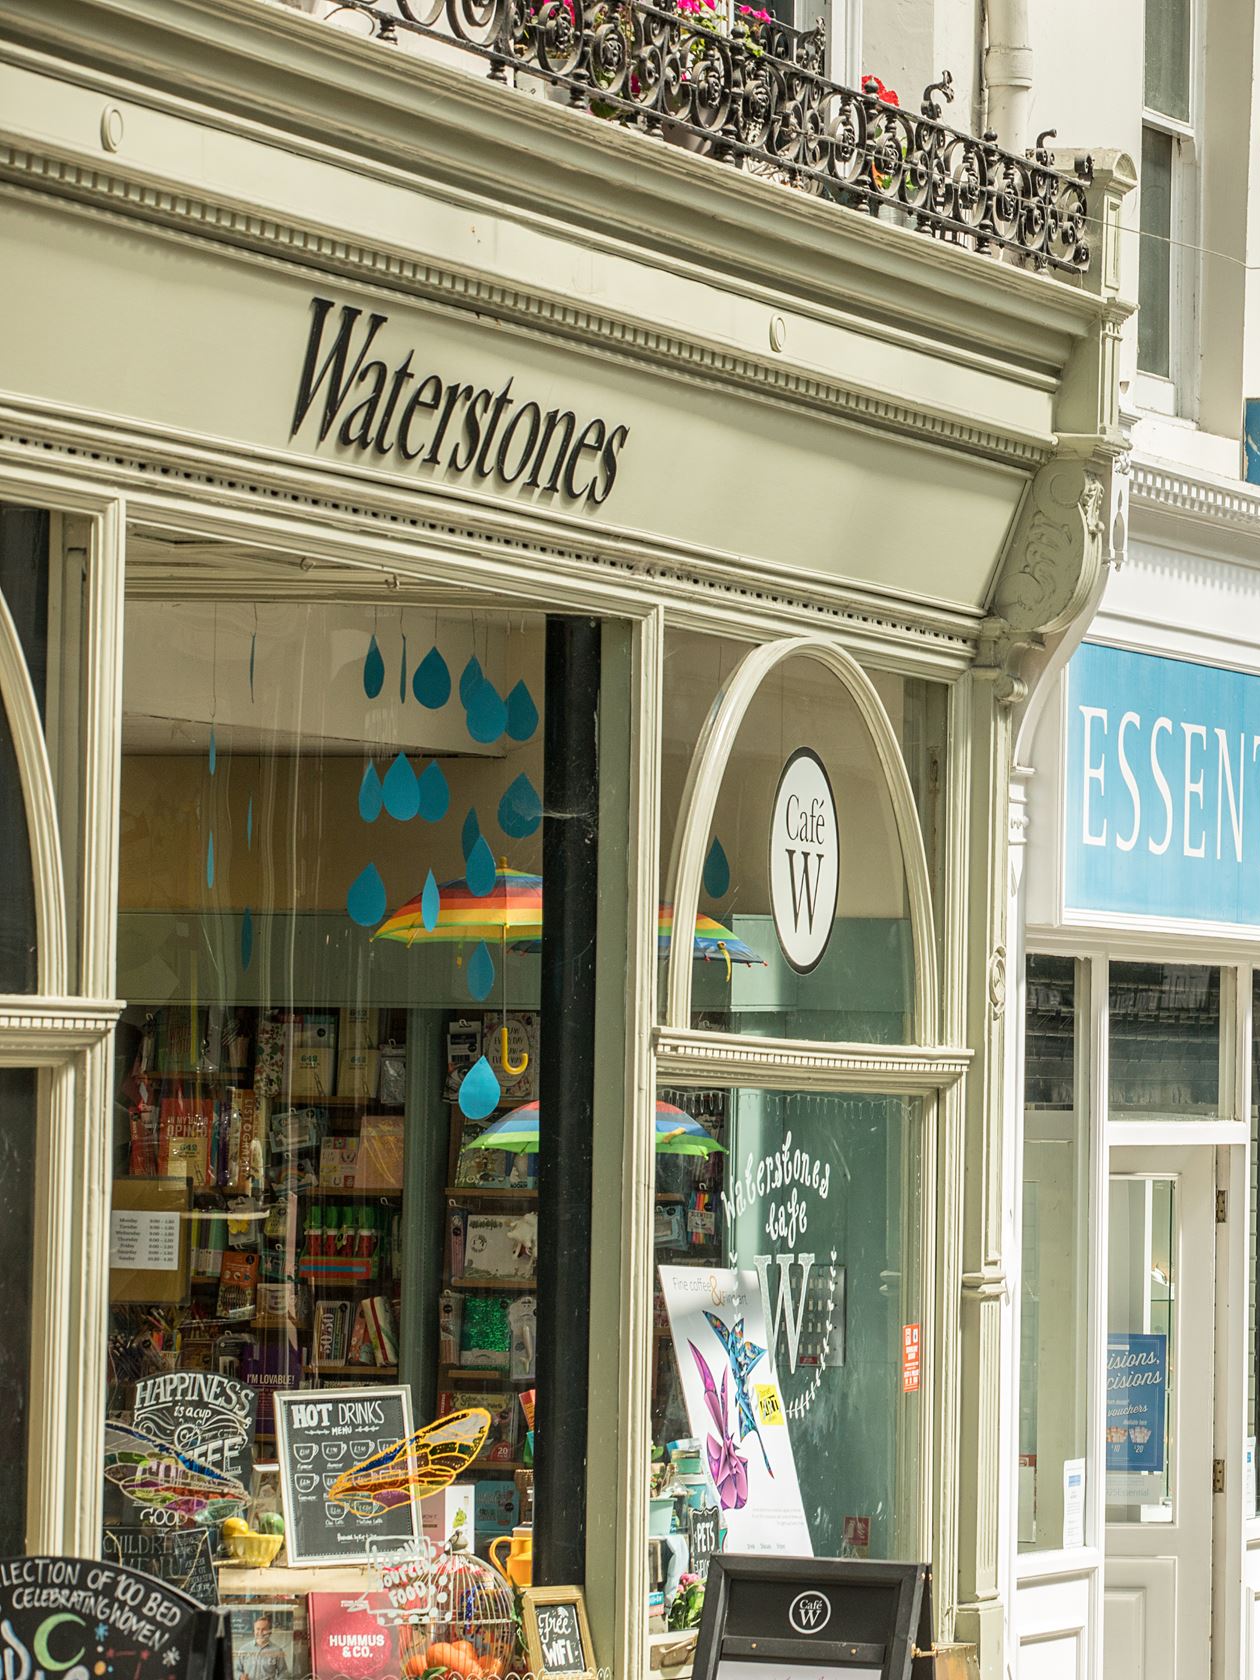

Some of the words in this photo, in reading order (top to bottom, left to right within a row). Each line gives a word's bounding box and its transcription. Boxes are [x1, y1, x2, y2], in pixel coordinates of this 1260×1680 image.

[290, 297, 630, 505] Waterstones
[786, 794, 825, 845] Café
[785, 848, 824, 935] W
[721, 1130, 831, 1228] Waterstones
[753, 1253, 815, 1375] W
[134, 1373, 255, 1417] HAPPINESS
[259, 1374, 295, 1385] LOVABLE!
[291, 1403, 333, 1429] HOT
[338, 1401, 385, 1425] DRINKS
[331, 1426, 353, 1436] MENU
[696, 1521, 716, 1553] PETS
[0, 1559, 81, 1588] LECTION
[87, 1568, 116, 1591] OF
[114, 1573, 146, 1607] 100
[142, 1591, 182, 1628] BED
[388, 1580, 427, 1608] FOOD
[799, 1599, 823, 1610] Café
[12, 1586, 111, 1621] CELEBRATING
[108, 1603, 170, 1651] WOMEN
[537, 1611, 572, 1643] Free
[799, 1608, 822, 1628] W
[329, 1634, 386, 1647] HUMMUS
[341, 1646, 352, 1658] &
[352, 1646, 374, 1658] CO.
[541, 1638, 574, 1668] WIFI
